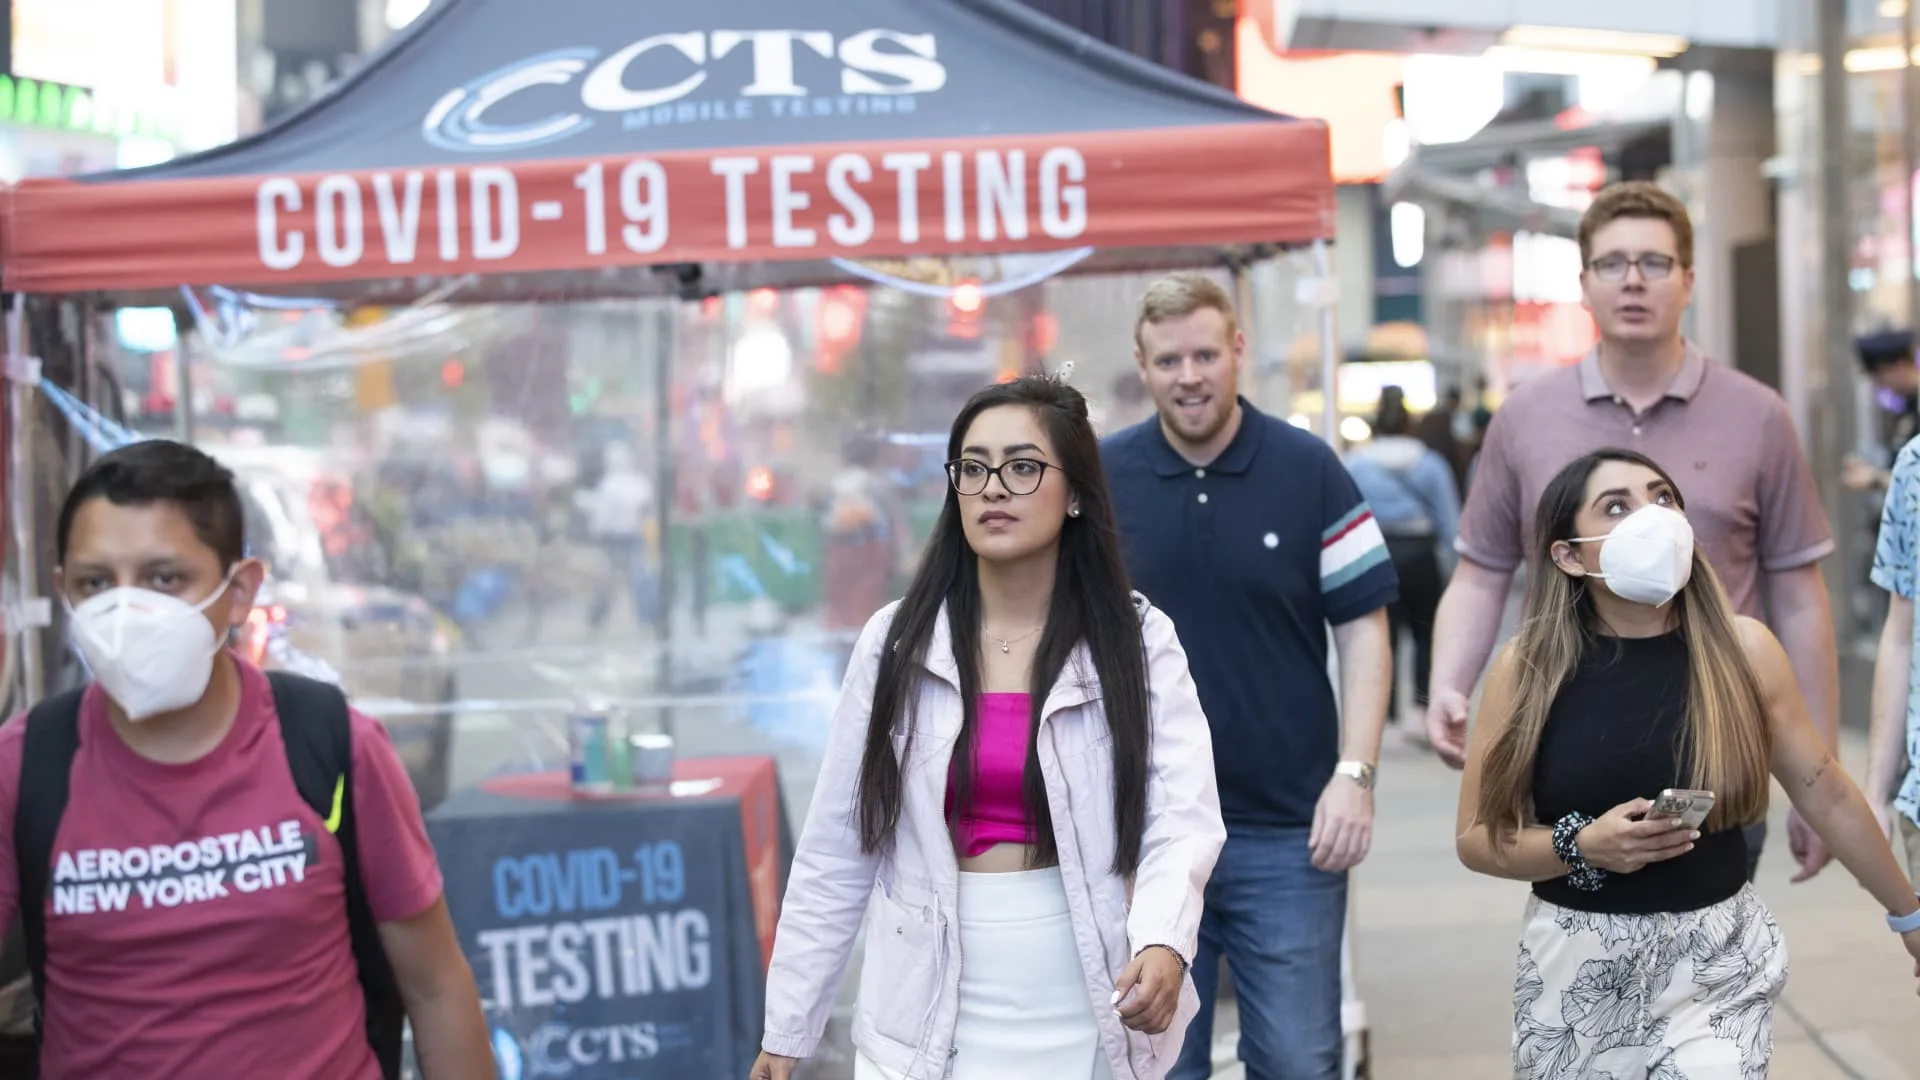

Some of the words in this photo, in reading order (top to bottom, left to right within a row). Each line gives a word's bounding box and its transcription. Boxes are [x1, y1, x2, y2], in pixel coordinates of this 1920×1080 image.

[622, 100, 752, 131] MOBILE
[769, 93, 917, 117] TESTING
[257, 159, 670, 270] COVID-19
[710, 147, 1088, 249] TESTING
[53, 882, 131, 915] NEW
[136, 868, 230, 908] YORK
[234, 852, 306, 893] CITY
[54, 820, 305, 883] AEROPOSTALE
[493, 839, 686, 919] COVID-19
[477, 908, 712, 1012] TESTING
